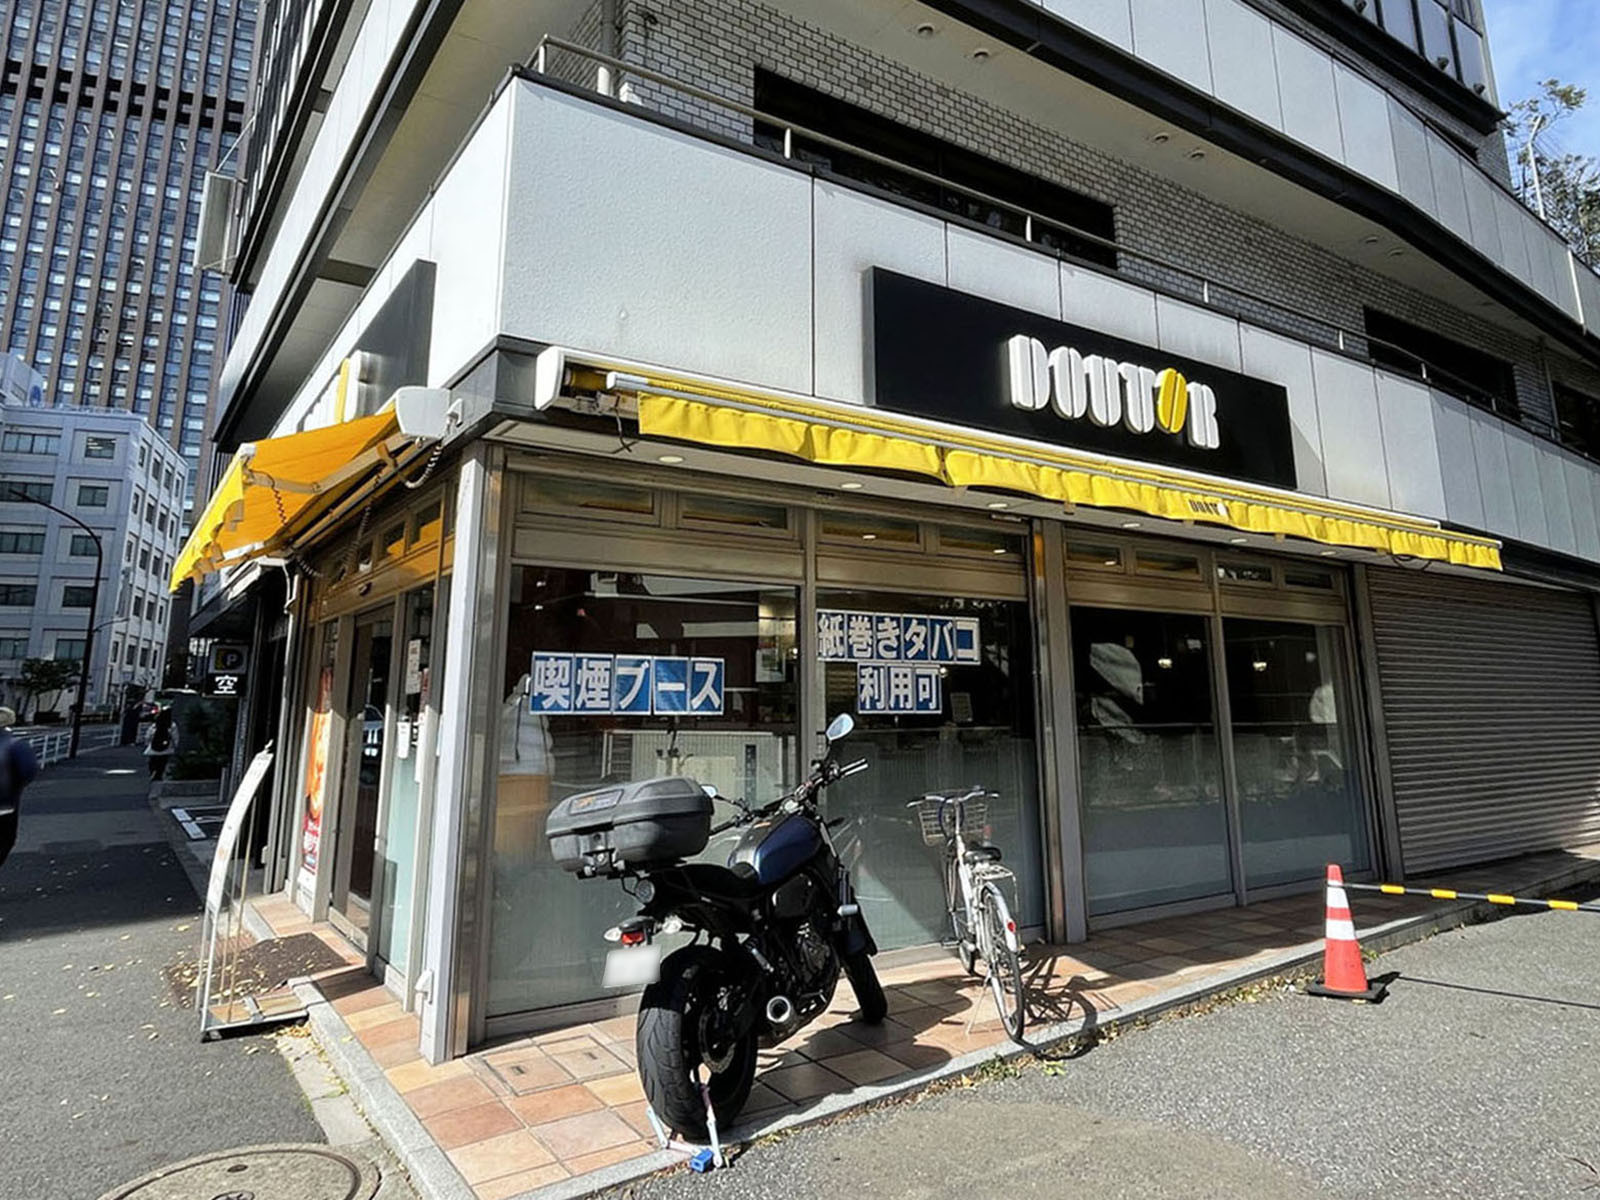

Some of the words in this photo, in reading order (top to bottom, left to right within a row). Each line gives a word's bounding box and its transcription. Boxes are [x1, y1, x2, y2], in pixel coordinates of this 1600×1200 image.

[1008, 334, 1220, 449] DOUTOR
[818, 613, 979, 661] 紙巻きタバコ
[213, 674, 238, 695] 空
[534, 657, 720, 710] 喫煙ブース
[860, 667, 938, 709] 利用可
